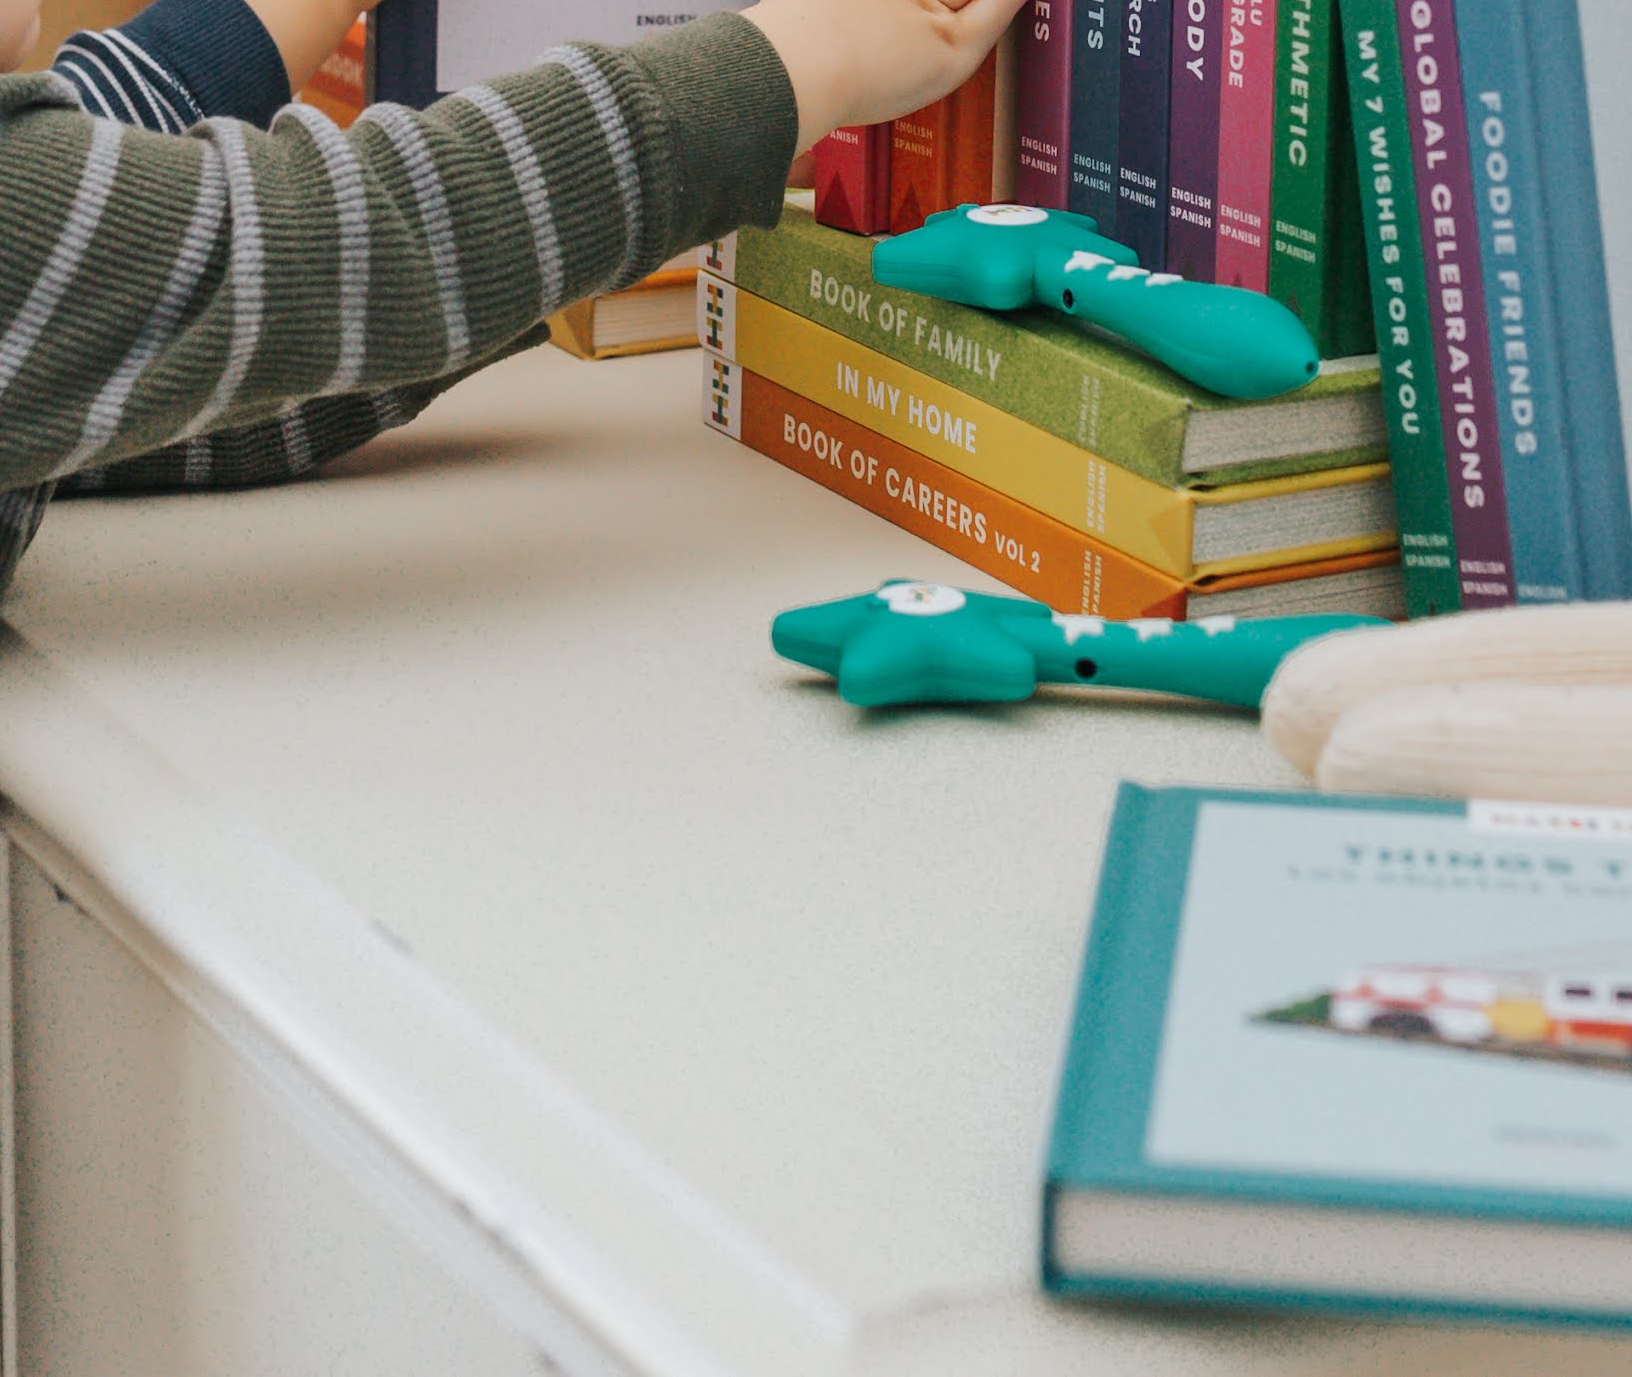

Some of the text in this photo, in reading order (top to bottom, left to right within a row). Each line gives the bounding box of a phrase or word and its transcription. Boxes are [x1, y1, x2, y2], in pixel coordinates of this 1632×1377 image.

[830, 129, 859, 145] ANISH
[894, 120, 934, 140] ENGLISH
[894, 137, 934, 159] SPANISH
[1021, 135, 1058, 158] ENGLISH
[1021, 153, 1058, 176] SPANISH
[1073, 153, 1111, 176] ENGLISH
[1073, 171, 1111, 194] SPANISH
[1120, 167, 1156, 190] ENGLISH
[1119, 185, 1156, 209] SPANISH
[1171, 186, 1211, 210] ENGLISH
[1170, 205, 1211, 229] SPANISH
[1220, 205, 1261, 228] ENGLISH
[1219, 223, 1260, 248] SPANISH
[1275, 221, 1316, 244] ENGLISH
[1356, 30, 1420, 435] MY 7 WISHES FOR YOU
[1275, 238, 1316, 263] SPANISH
[1410, 0, 1485, 509] GLOBAL CELEBRATIONS
[1478, 91, 1539, 456] FOODIE FRIENDS
[810, 269, 1002, 381] BOOK OF FAMILY
[836, 361, 977, 454] IN MY HOME
[783, 413, 1041, 574] BOOK OF CAREERS VOL 2
[1092, 555, 1103, 614] PANISH
